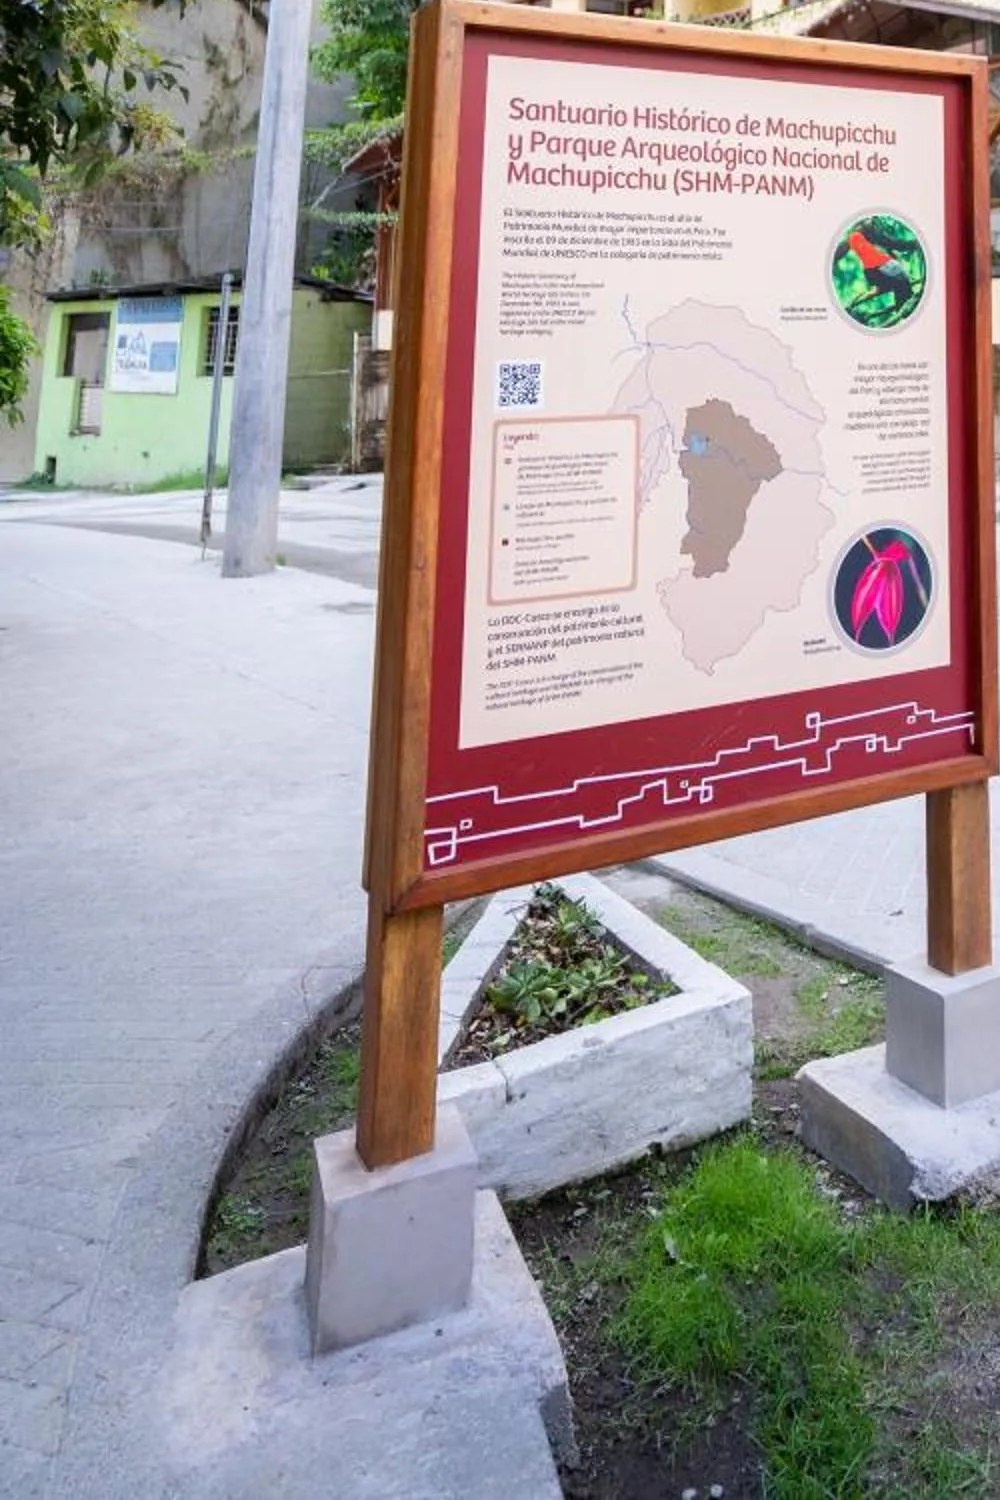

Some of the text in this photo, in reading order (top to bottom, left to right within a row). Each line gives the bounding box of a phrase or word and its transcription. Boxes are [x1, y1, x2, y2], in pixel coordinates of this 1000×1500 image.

[508, 97, 897, 147] Santuario Histórico de Machupicchu
[508, 131, 890, 173] y Parque Arqueológico Nacional de
[507, 161, 815, 202] Machupicchu (SHM-PANM)
